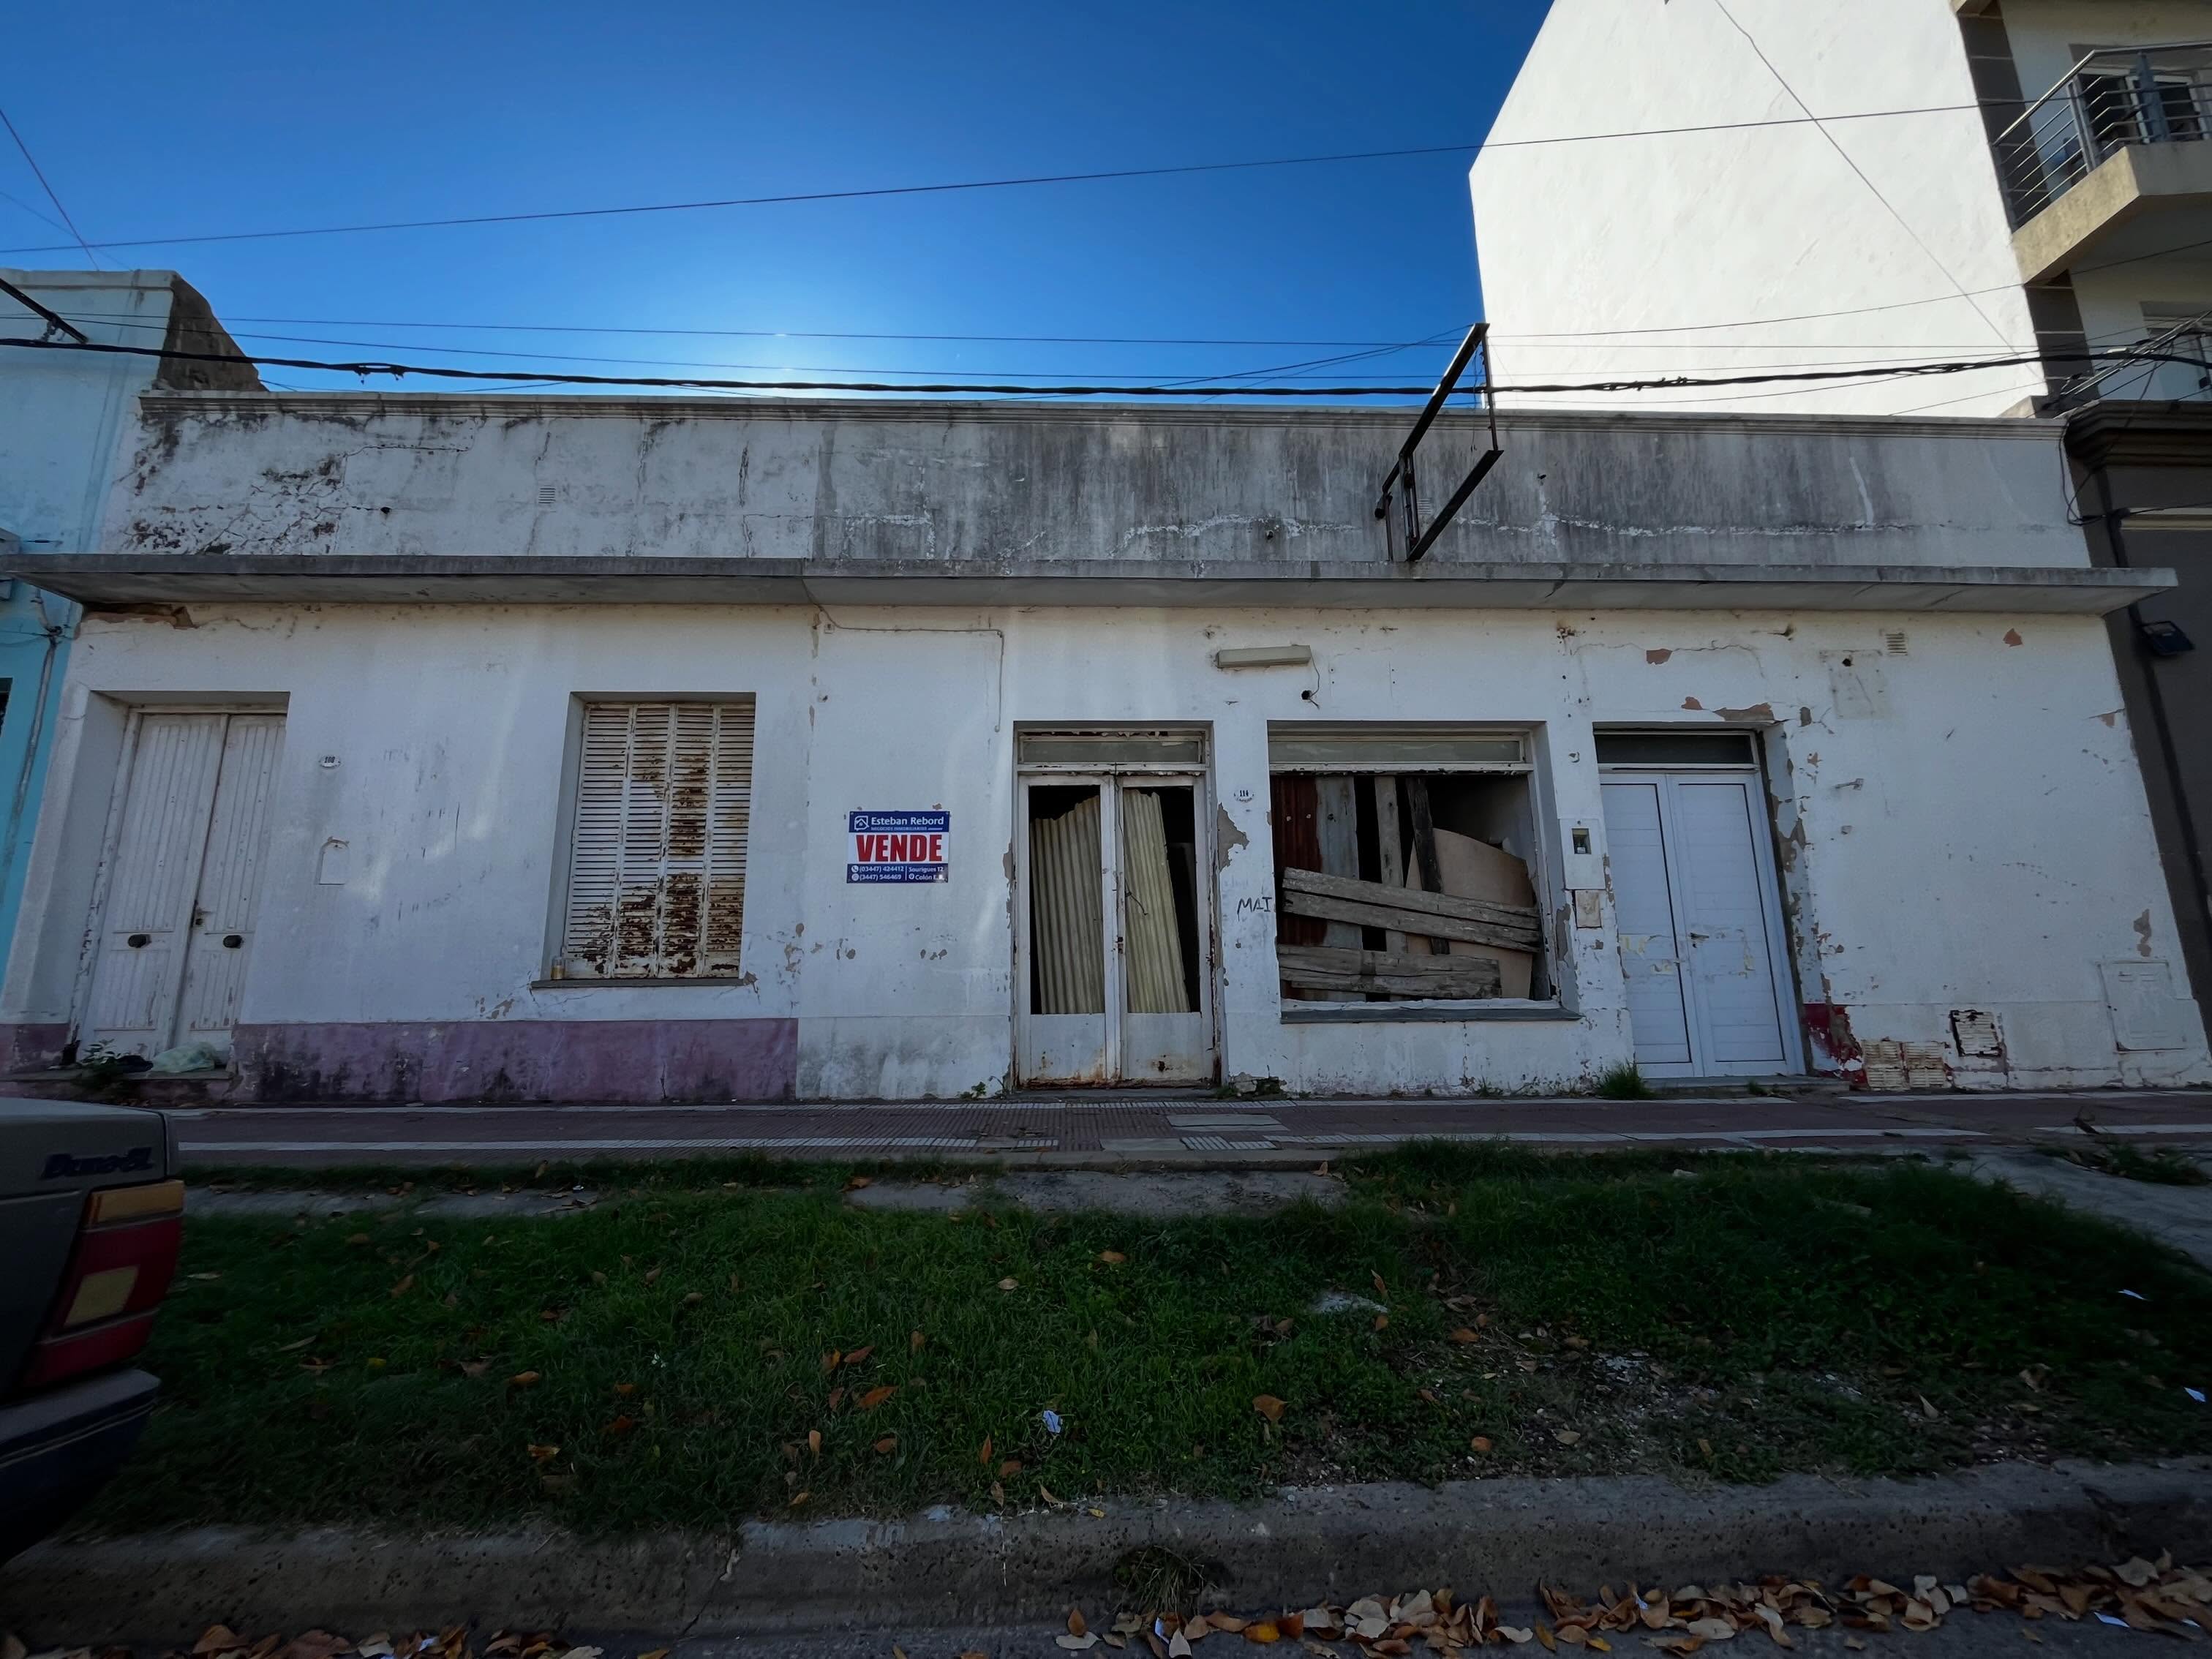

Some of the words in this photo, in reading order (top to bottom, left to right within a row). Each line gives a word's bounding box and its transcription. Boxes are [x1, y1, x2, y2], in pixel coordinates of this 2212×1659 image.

[870, 816, 907, 825] Esteban
[910, 816, 944, 825] Rebord
[856, 834, 942, 862] VENDE
